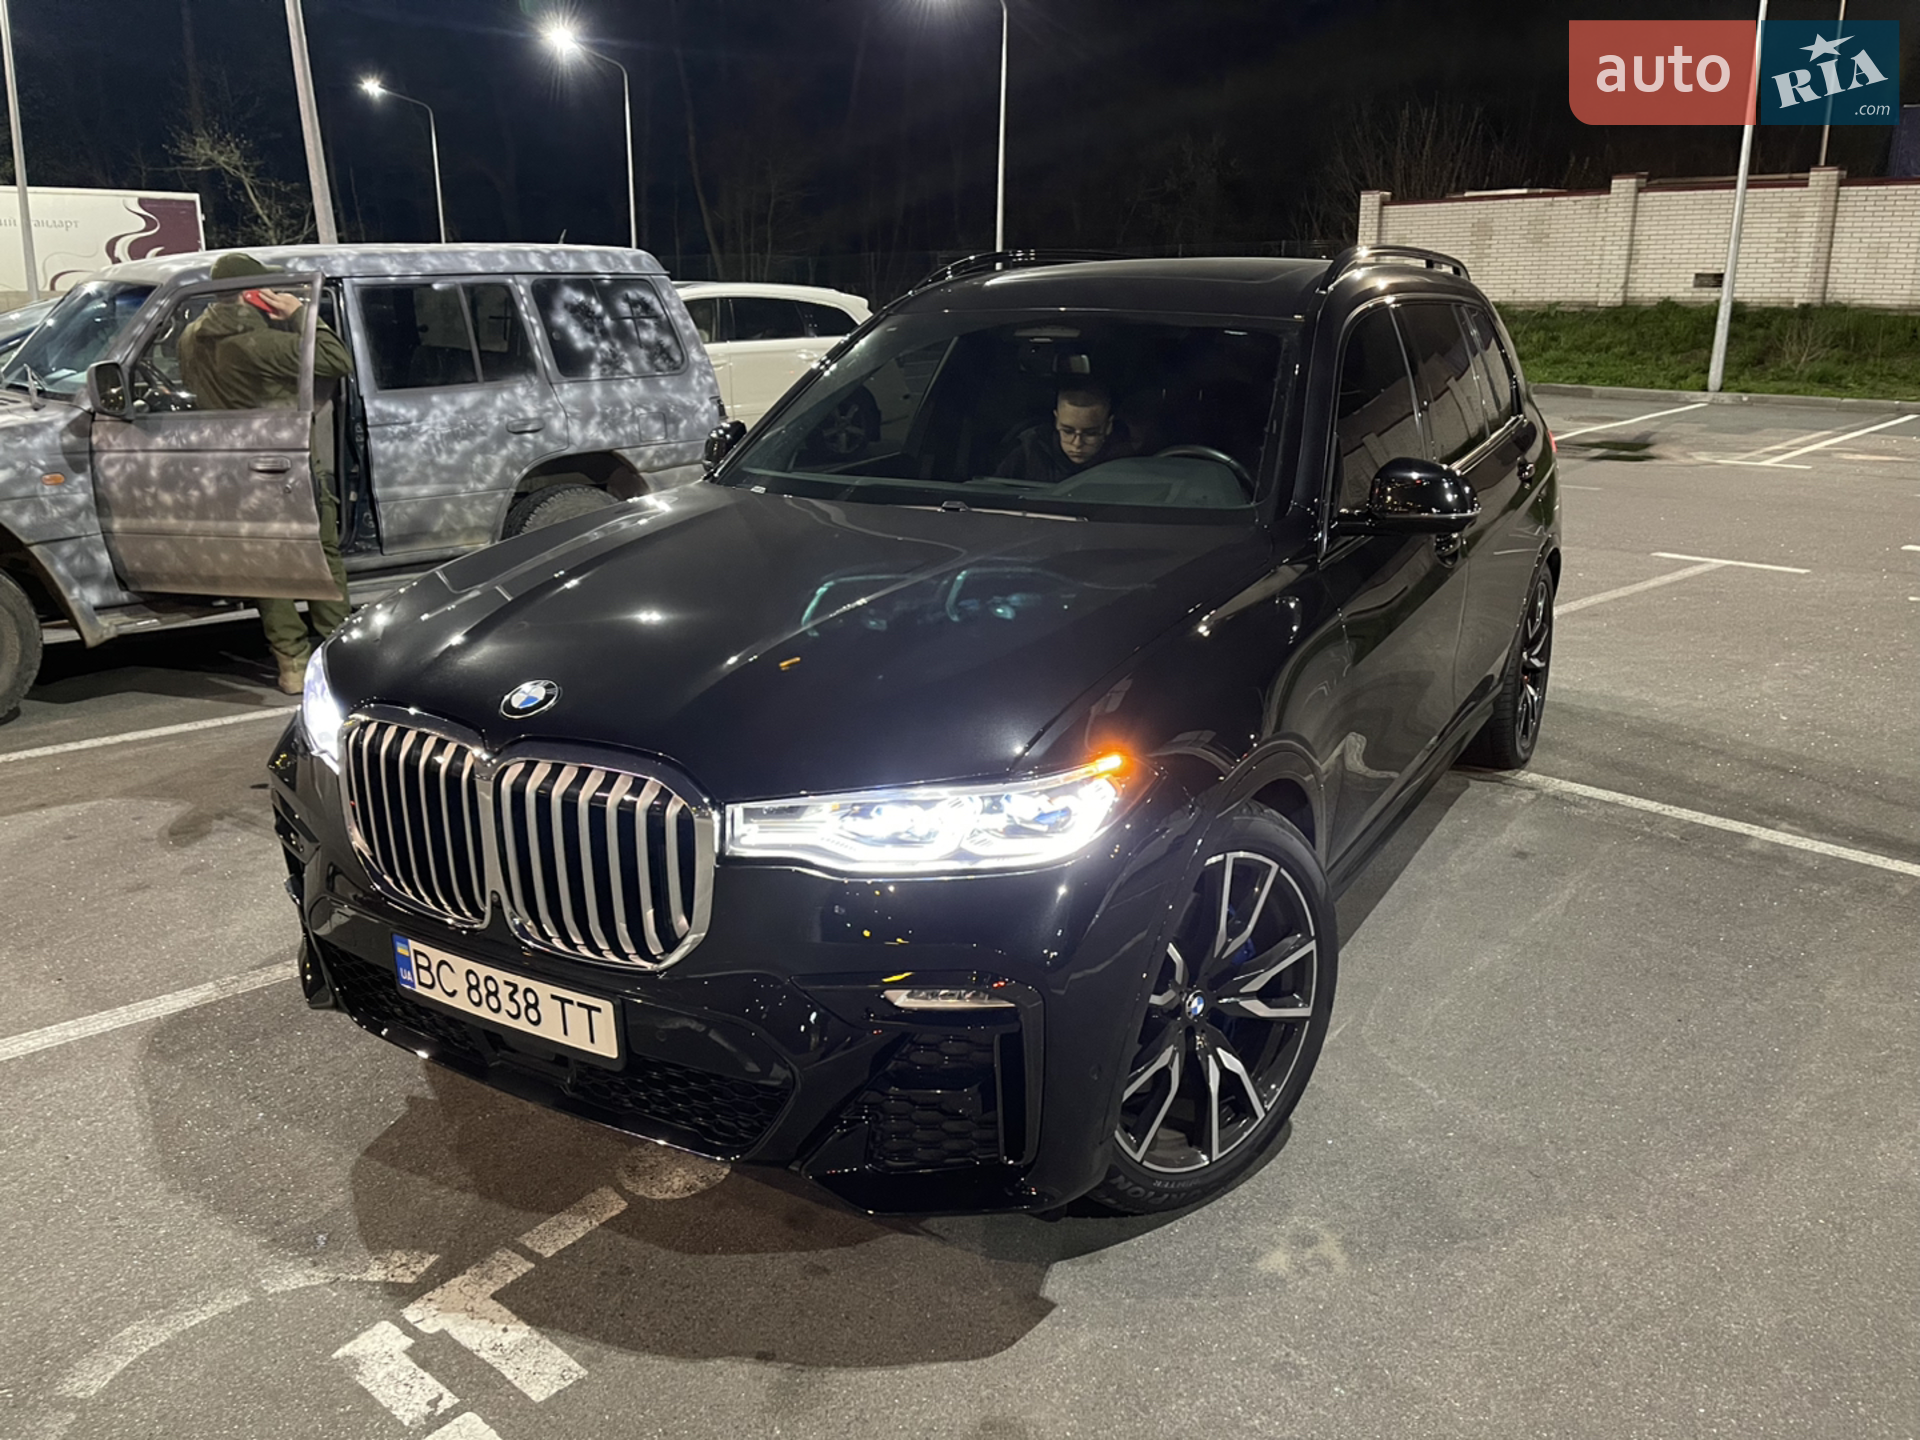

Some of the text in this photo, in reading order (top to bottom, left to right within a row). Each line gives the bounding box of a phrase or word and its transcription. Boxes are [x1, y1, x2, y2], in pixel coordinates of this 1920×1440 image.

[30, 219, 80, 232] андарт
[400, 967, 414, 982] UA
[413, 949, 602, 1044] BC 8838 TT
